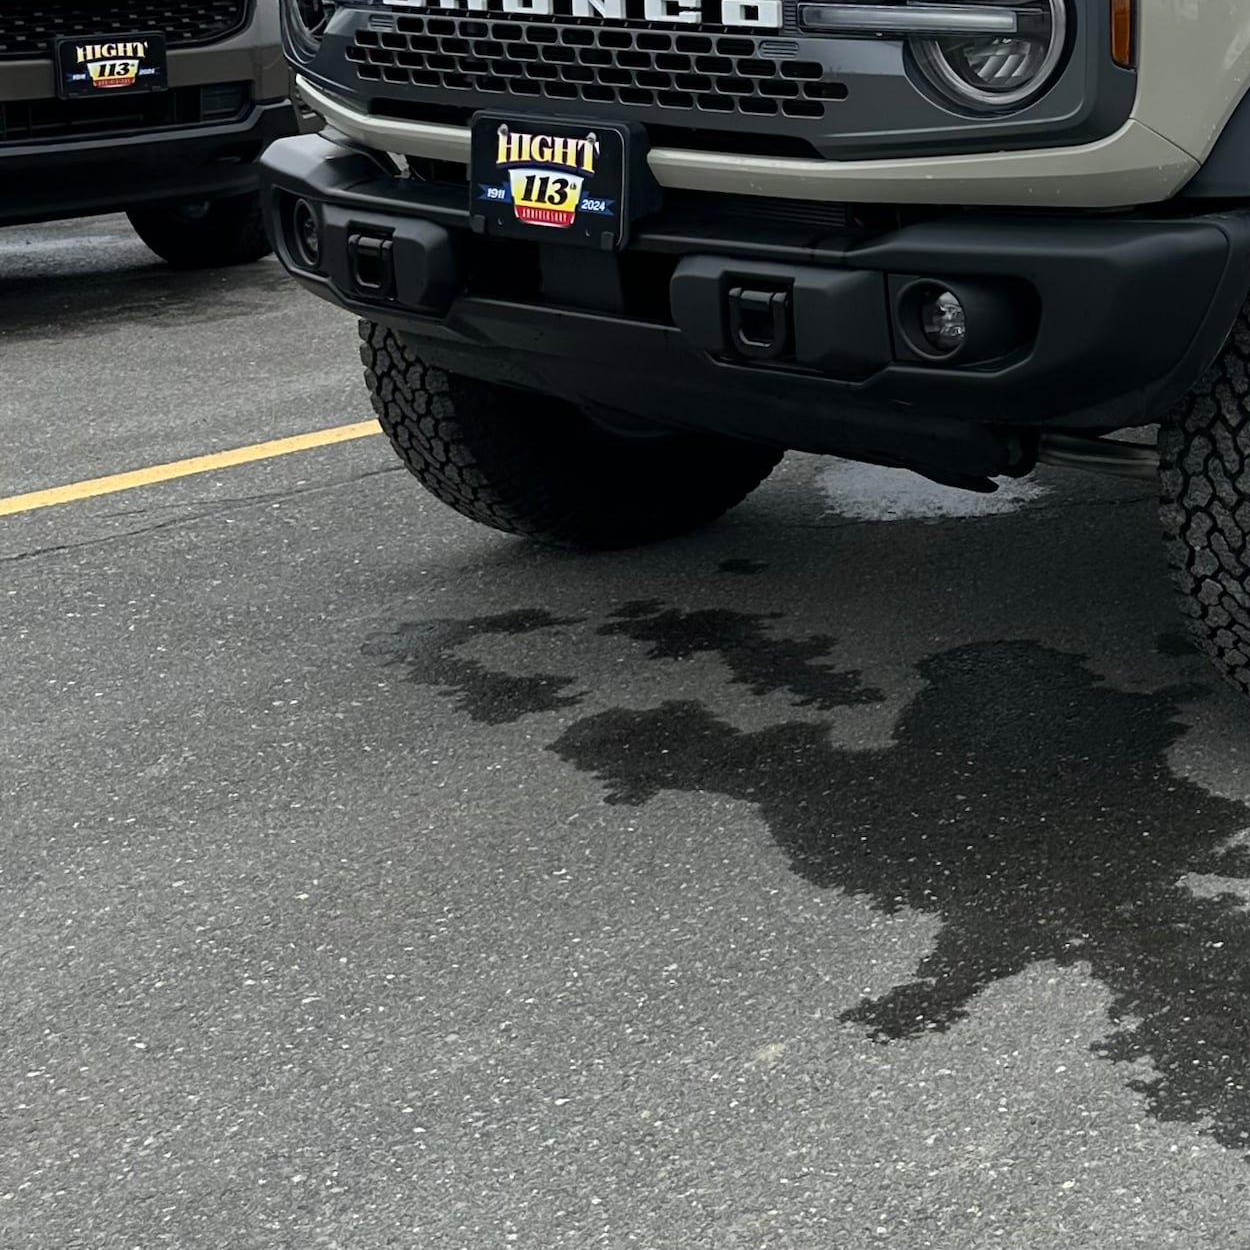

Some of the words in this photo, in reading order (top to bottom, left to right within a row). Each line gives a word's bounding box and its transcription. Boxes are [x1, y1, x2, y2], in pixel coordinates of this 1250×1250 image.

[76, 41, 148, 63] HIGHT
[496, 131, 600, 174] HIGHT
[487, 188, 505, 200] 1911
[581, 199, 605, 211] 2024
[522, 207, 567, 223] ANNIVERSARY
